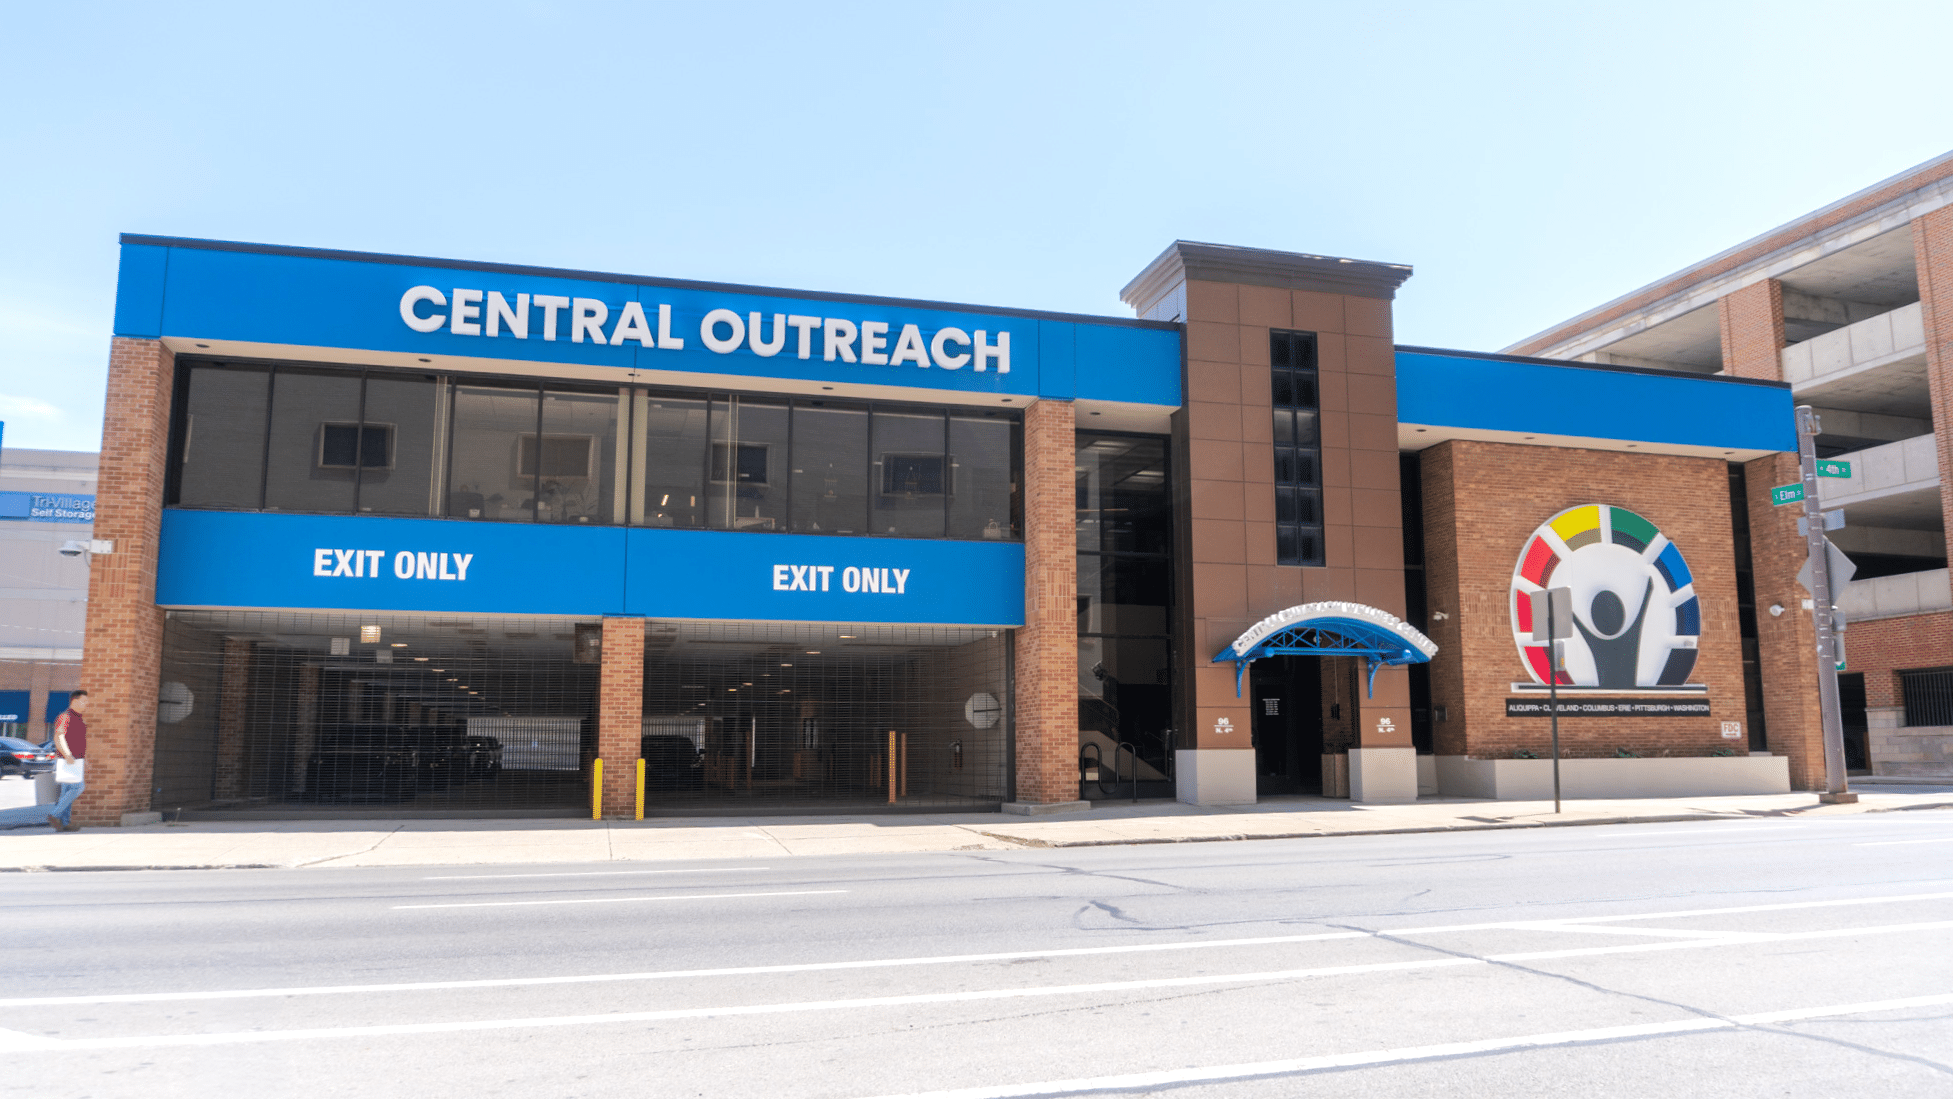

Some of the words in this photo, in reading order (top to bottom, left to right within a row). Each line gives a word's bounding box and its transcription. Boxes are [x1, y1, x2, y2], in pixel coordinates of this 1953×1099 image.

[400, 285, 684, 350] CENTRAL
[700, 308, 1010, 373] OUTREACH
[31, 508, 54, 517] Self
[313, 548, 385, 578] EXIT
[394, 550, 474, 581] ONLY
[773, 564, 834, 592] EXIT
[842, 566, 910, 594] ONLY
[1508, 704, 1540, 712] ALIQUIPPA
[1543, 704, 1579, 712] CLVELAND
[1582, 704, 1615, 712] COLUMBUS
[1618, 704, 1631, 712] ERIE
[1634, 704, 1671, 712] PITTSBURGH
[1673, 704, 1710, 712] WASHINGTON
[1217, 717, 1230, 725] 96
[1380, 717, 1391, 725] 96
[1724, 723, 1739, 733] FDC
